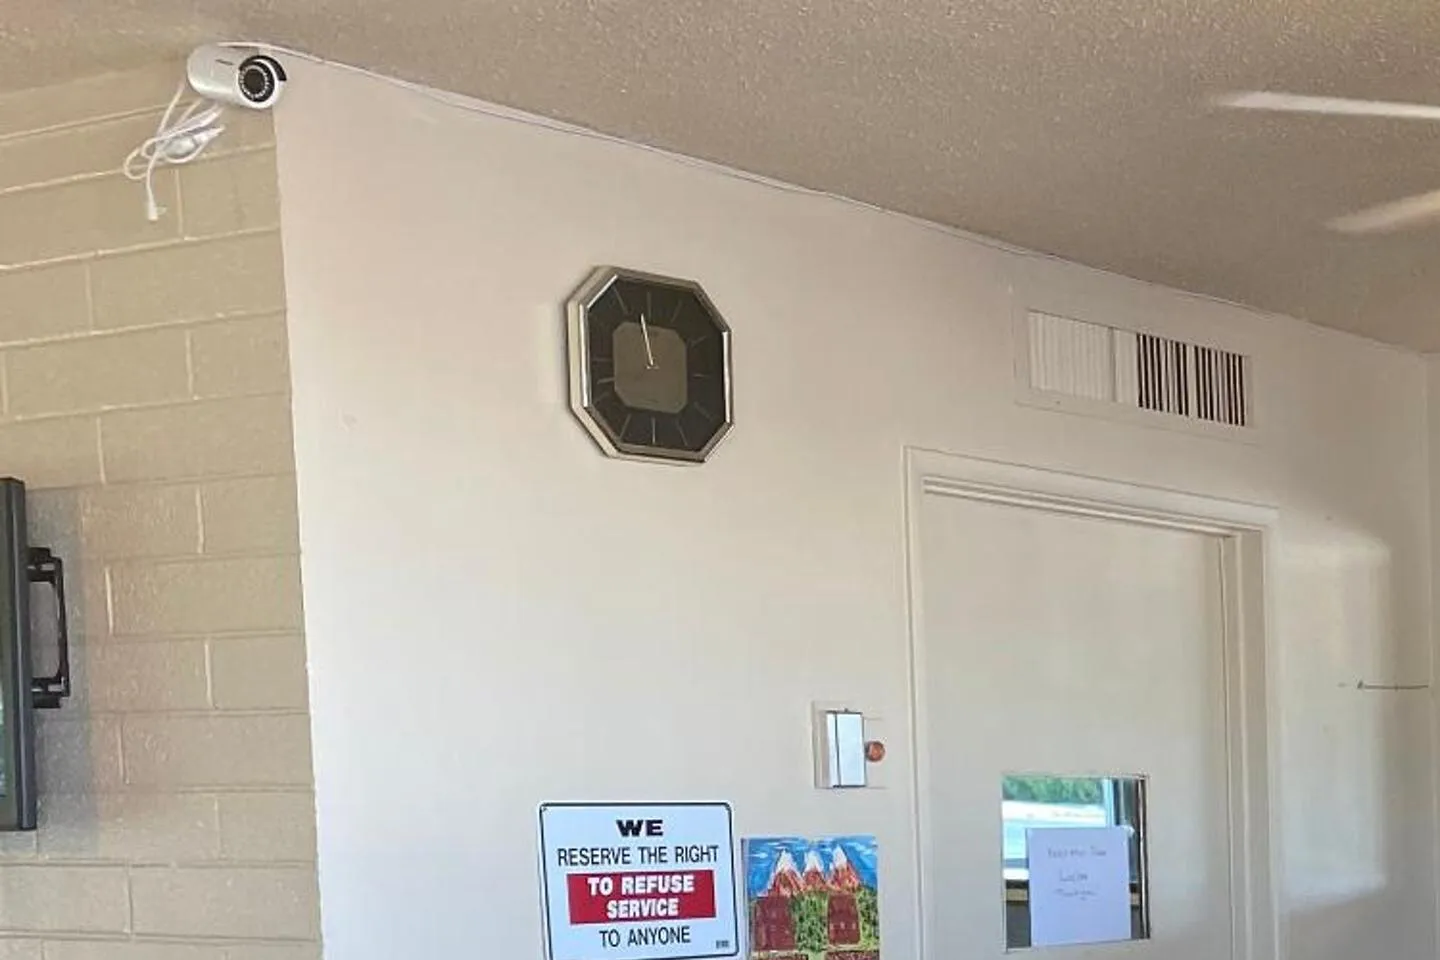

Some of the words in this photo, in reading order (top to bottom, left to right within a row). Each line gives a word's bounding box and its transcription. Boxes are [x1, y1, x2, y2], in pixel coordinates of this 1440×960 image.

[616, 819, 664, 837] WE
[557, 845, 631, 866] RESERVE
[637, 845, 668, 864] THE
[675, 844, 719, 863] RIGHT
[587, 877, 611, 896] TO
[621, 874, 694, 895] REFUSE
[607, 898, 679, 919] SERVICE
[599, 928, 620, 948] TO
[627, 926, 691, 946] ANYONE
